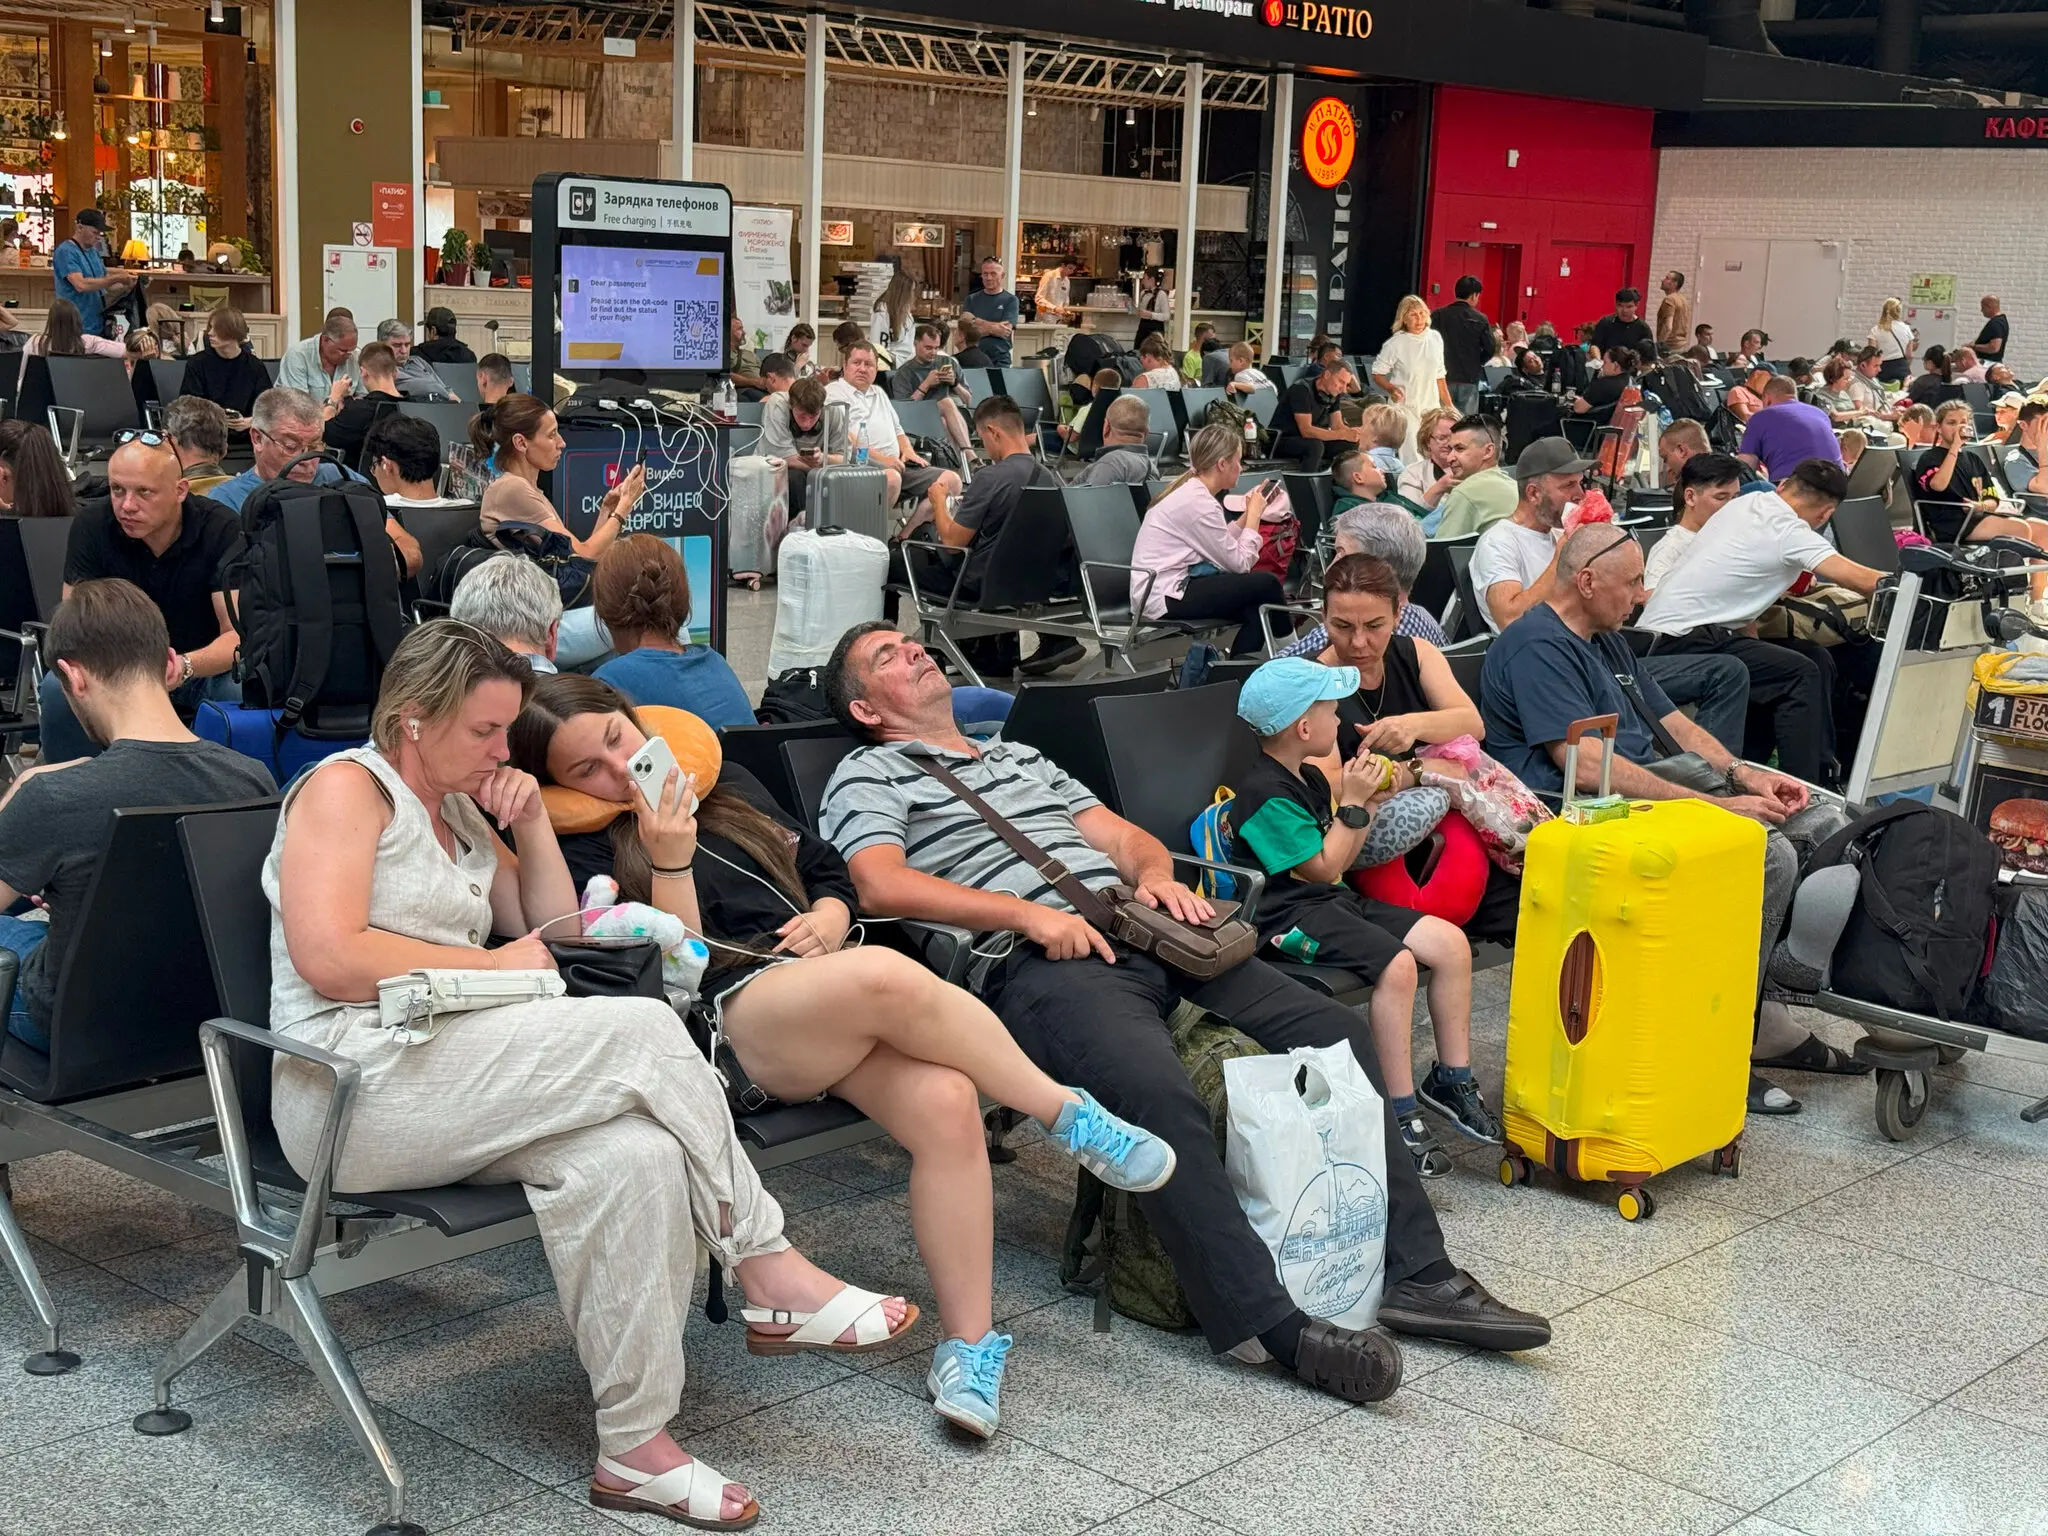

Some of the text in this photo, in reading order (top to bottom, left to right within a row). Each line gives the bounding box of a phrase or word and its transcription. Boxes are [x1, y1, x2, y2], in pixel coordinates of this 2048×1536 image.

[1286, 2, 1373, 39] IL PATIO
[1984, 116, 2048, 139] КАФЕ
[603, 191, 719, 213] Зарядка телефонов
[603, 213, 657, 228] Free charging
[590, 279, 607, 287] Dear
[590, 297, 669, 307] Please scan the QR-code
[599, 305, 613, 313] find
[613, 306, 625, 314] out
[626, 306, 638, 314] the
[638, 307, 659, 315] status
[590, 314, 598, 322] of
[599, 315, 614, 323] your
[646, 467, 685, 482] Видео
[653, 491, 703, 511] ВИДЕО
[621, 510, 684, 534] ДОРОГУ
[1988, 696, 2006, 725] 1
[1303, 1248, 1364, 1296] Самара
